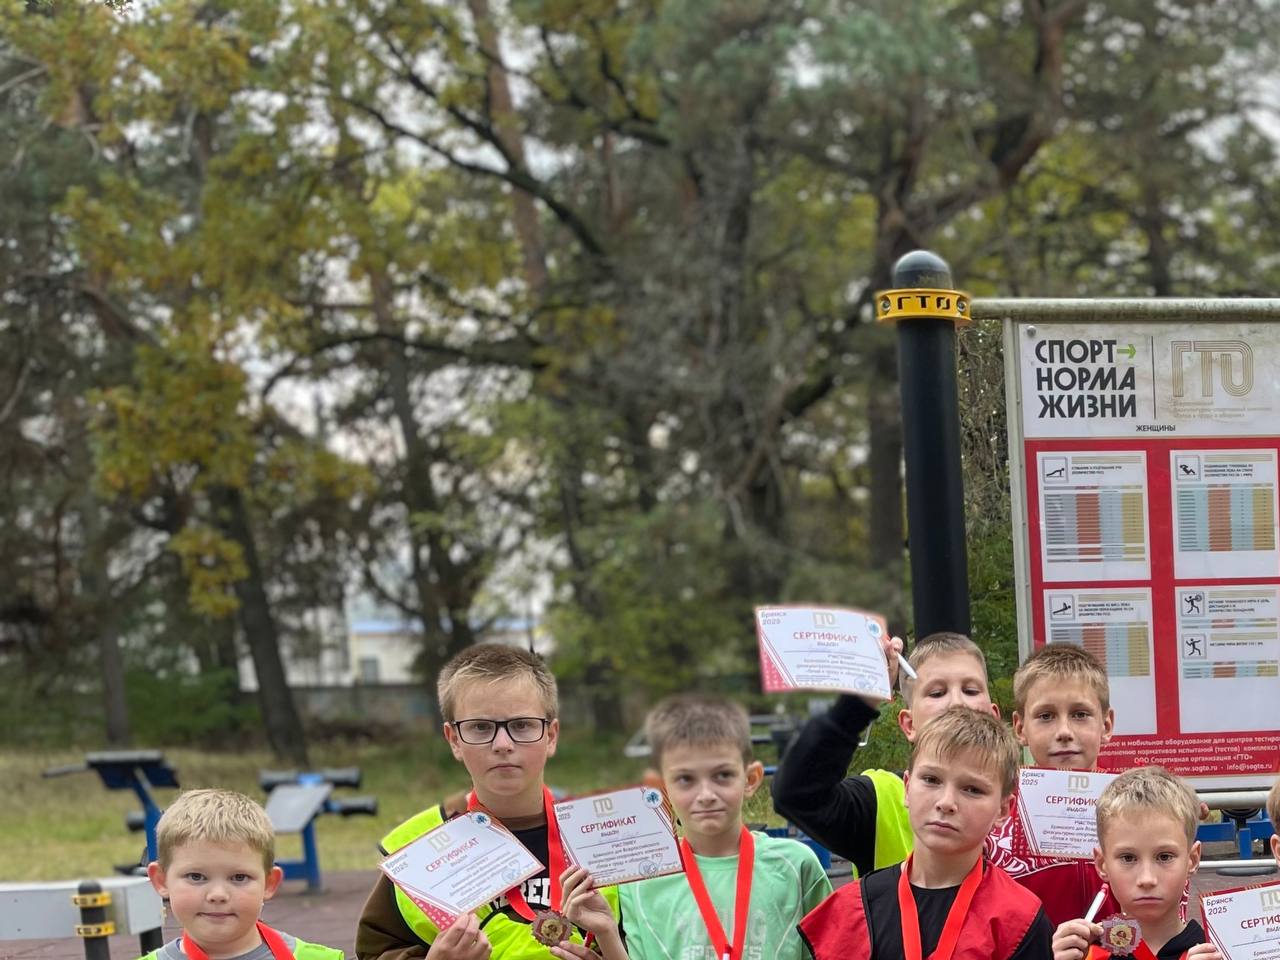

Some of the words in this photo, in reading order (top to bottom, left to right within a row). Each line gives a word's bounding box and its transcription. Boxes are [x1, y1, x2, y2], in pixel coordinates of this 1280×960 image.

[897, 296, 950, 310] ГТО
[1035, 339, 1117, 363] СПОРТ
[1036, 367, 1136, 391] НОРМА
[1038, 394, 1137, 418] ЖИЗНИ
[1136, 424, 1176, 432] ЖЕНЩИНЫ
[793, 631, 858, 643] СЕРТИФИКАТ
[1046, 795, 1097, 806] СЕРТИФИК
[579, 814, 637, 834] СЕРТИФИКАТ
[423, 837, 480, 873] СЕРТИФИКАТ
[1206, 896, 1233, 906] Брянск
[1208, 905, 1227, 915] 2025
